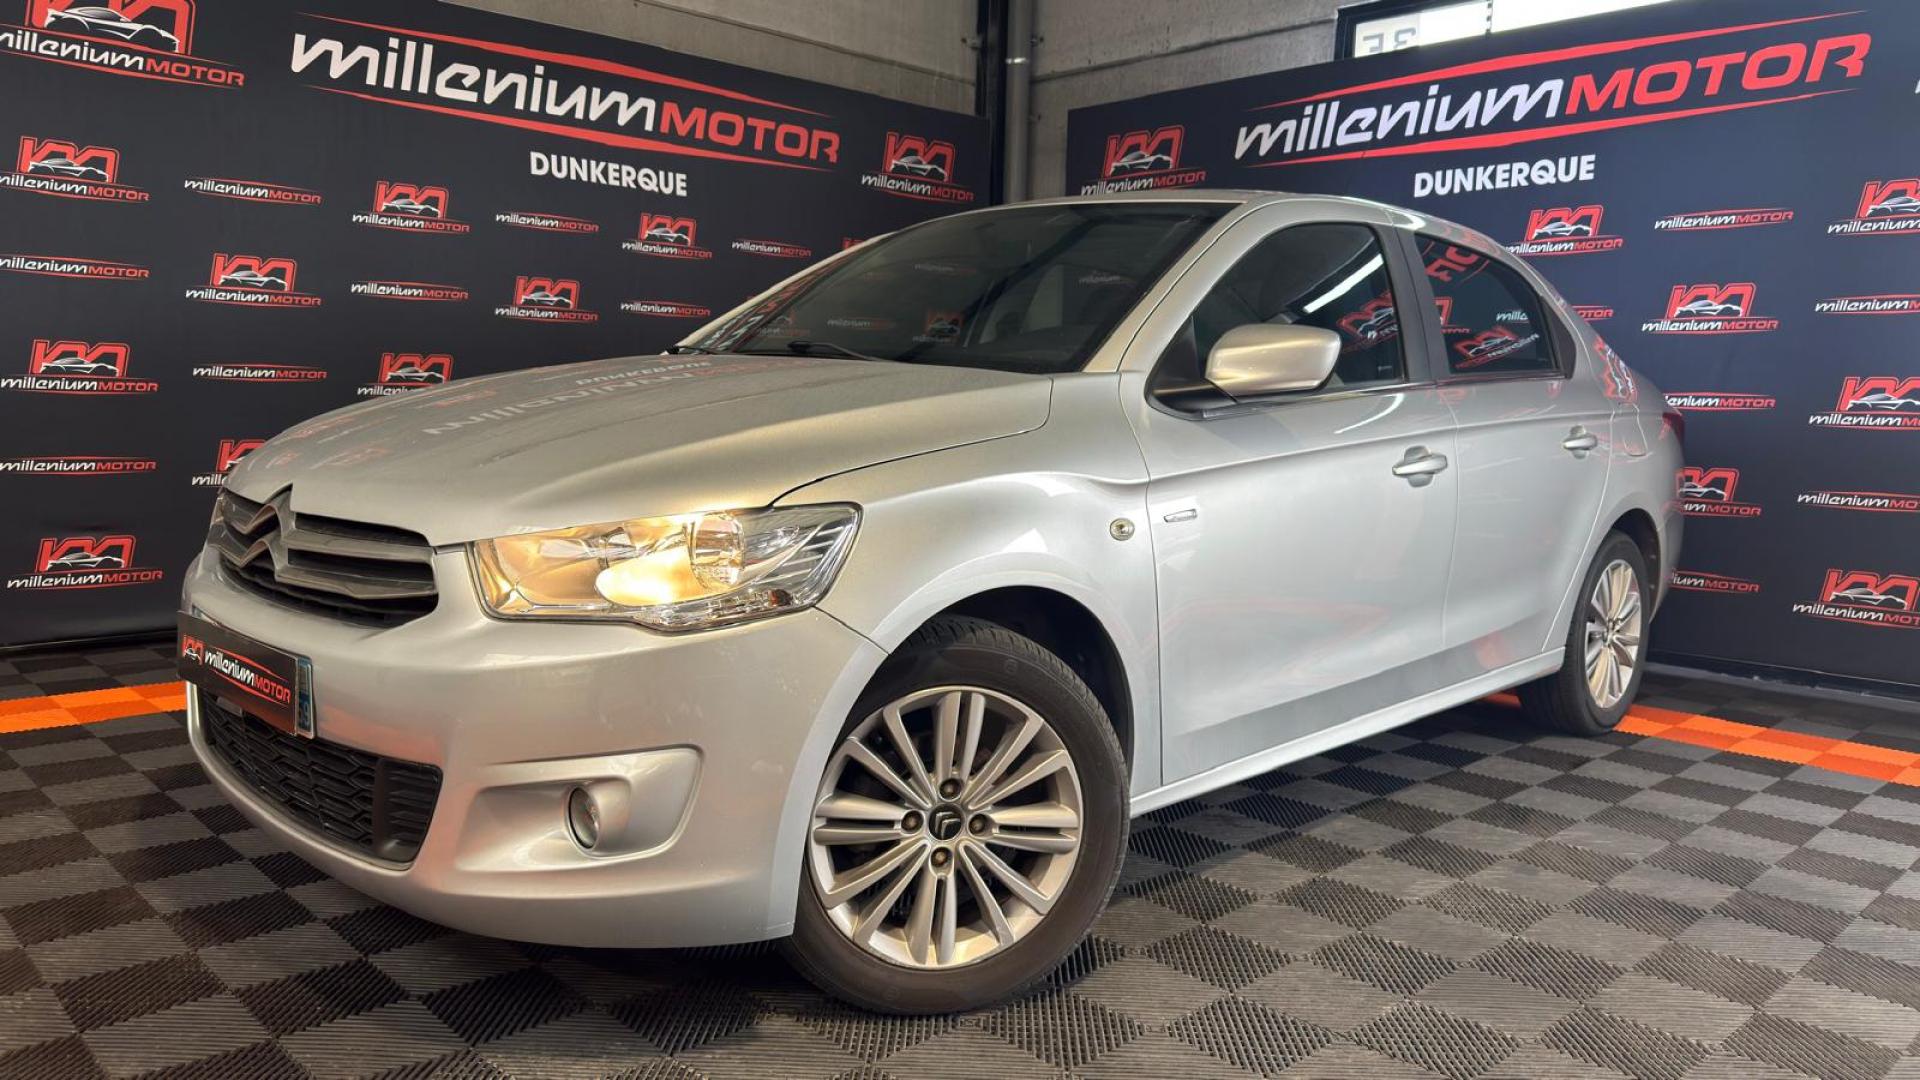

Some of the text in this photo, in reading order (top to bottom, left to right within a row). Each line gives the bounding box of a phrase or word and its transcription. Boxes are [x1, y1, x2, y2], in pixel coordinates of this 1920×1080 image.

[291, 33, 840, 163] milleniumMOTOR
[1234, 33, 1872, 160] milleniumMOTOR
[529, 151, 688, 197] DUNKERQUE
[1414, 154, 1596, 198] DUNKERQUE
[184, 179, 322, 204] milleniumMOTOR
[352, 212, 471, 233] milleniumMOTOR
[495, 212, 600, 232] milleniumMOTOR
[1654, 210, 1794, 230] milleniumMOTOR
[1827, 218, 1920, 234] millenium
[185, 288, 322, 306] milleniumMOTOR
[1814, 299, 1920, 312] milleniumM
[192, 364, 328, 380] milleniumMOTOR
[0, 375, 159, 392] milleniumMOTOR
[1664, 395, 1777, 408] eniumMOTOR
[1808, 413, 1920, 426] milleniumM
[1797, 492, 1920, 509] milleniumMO
[7, 568, 164, 589] milleniumMOTOR
[1792, 603, 1920, 626] milleniumMOT
